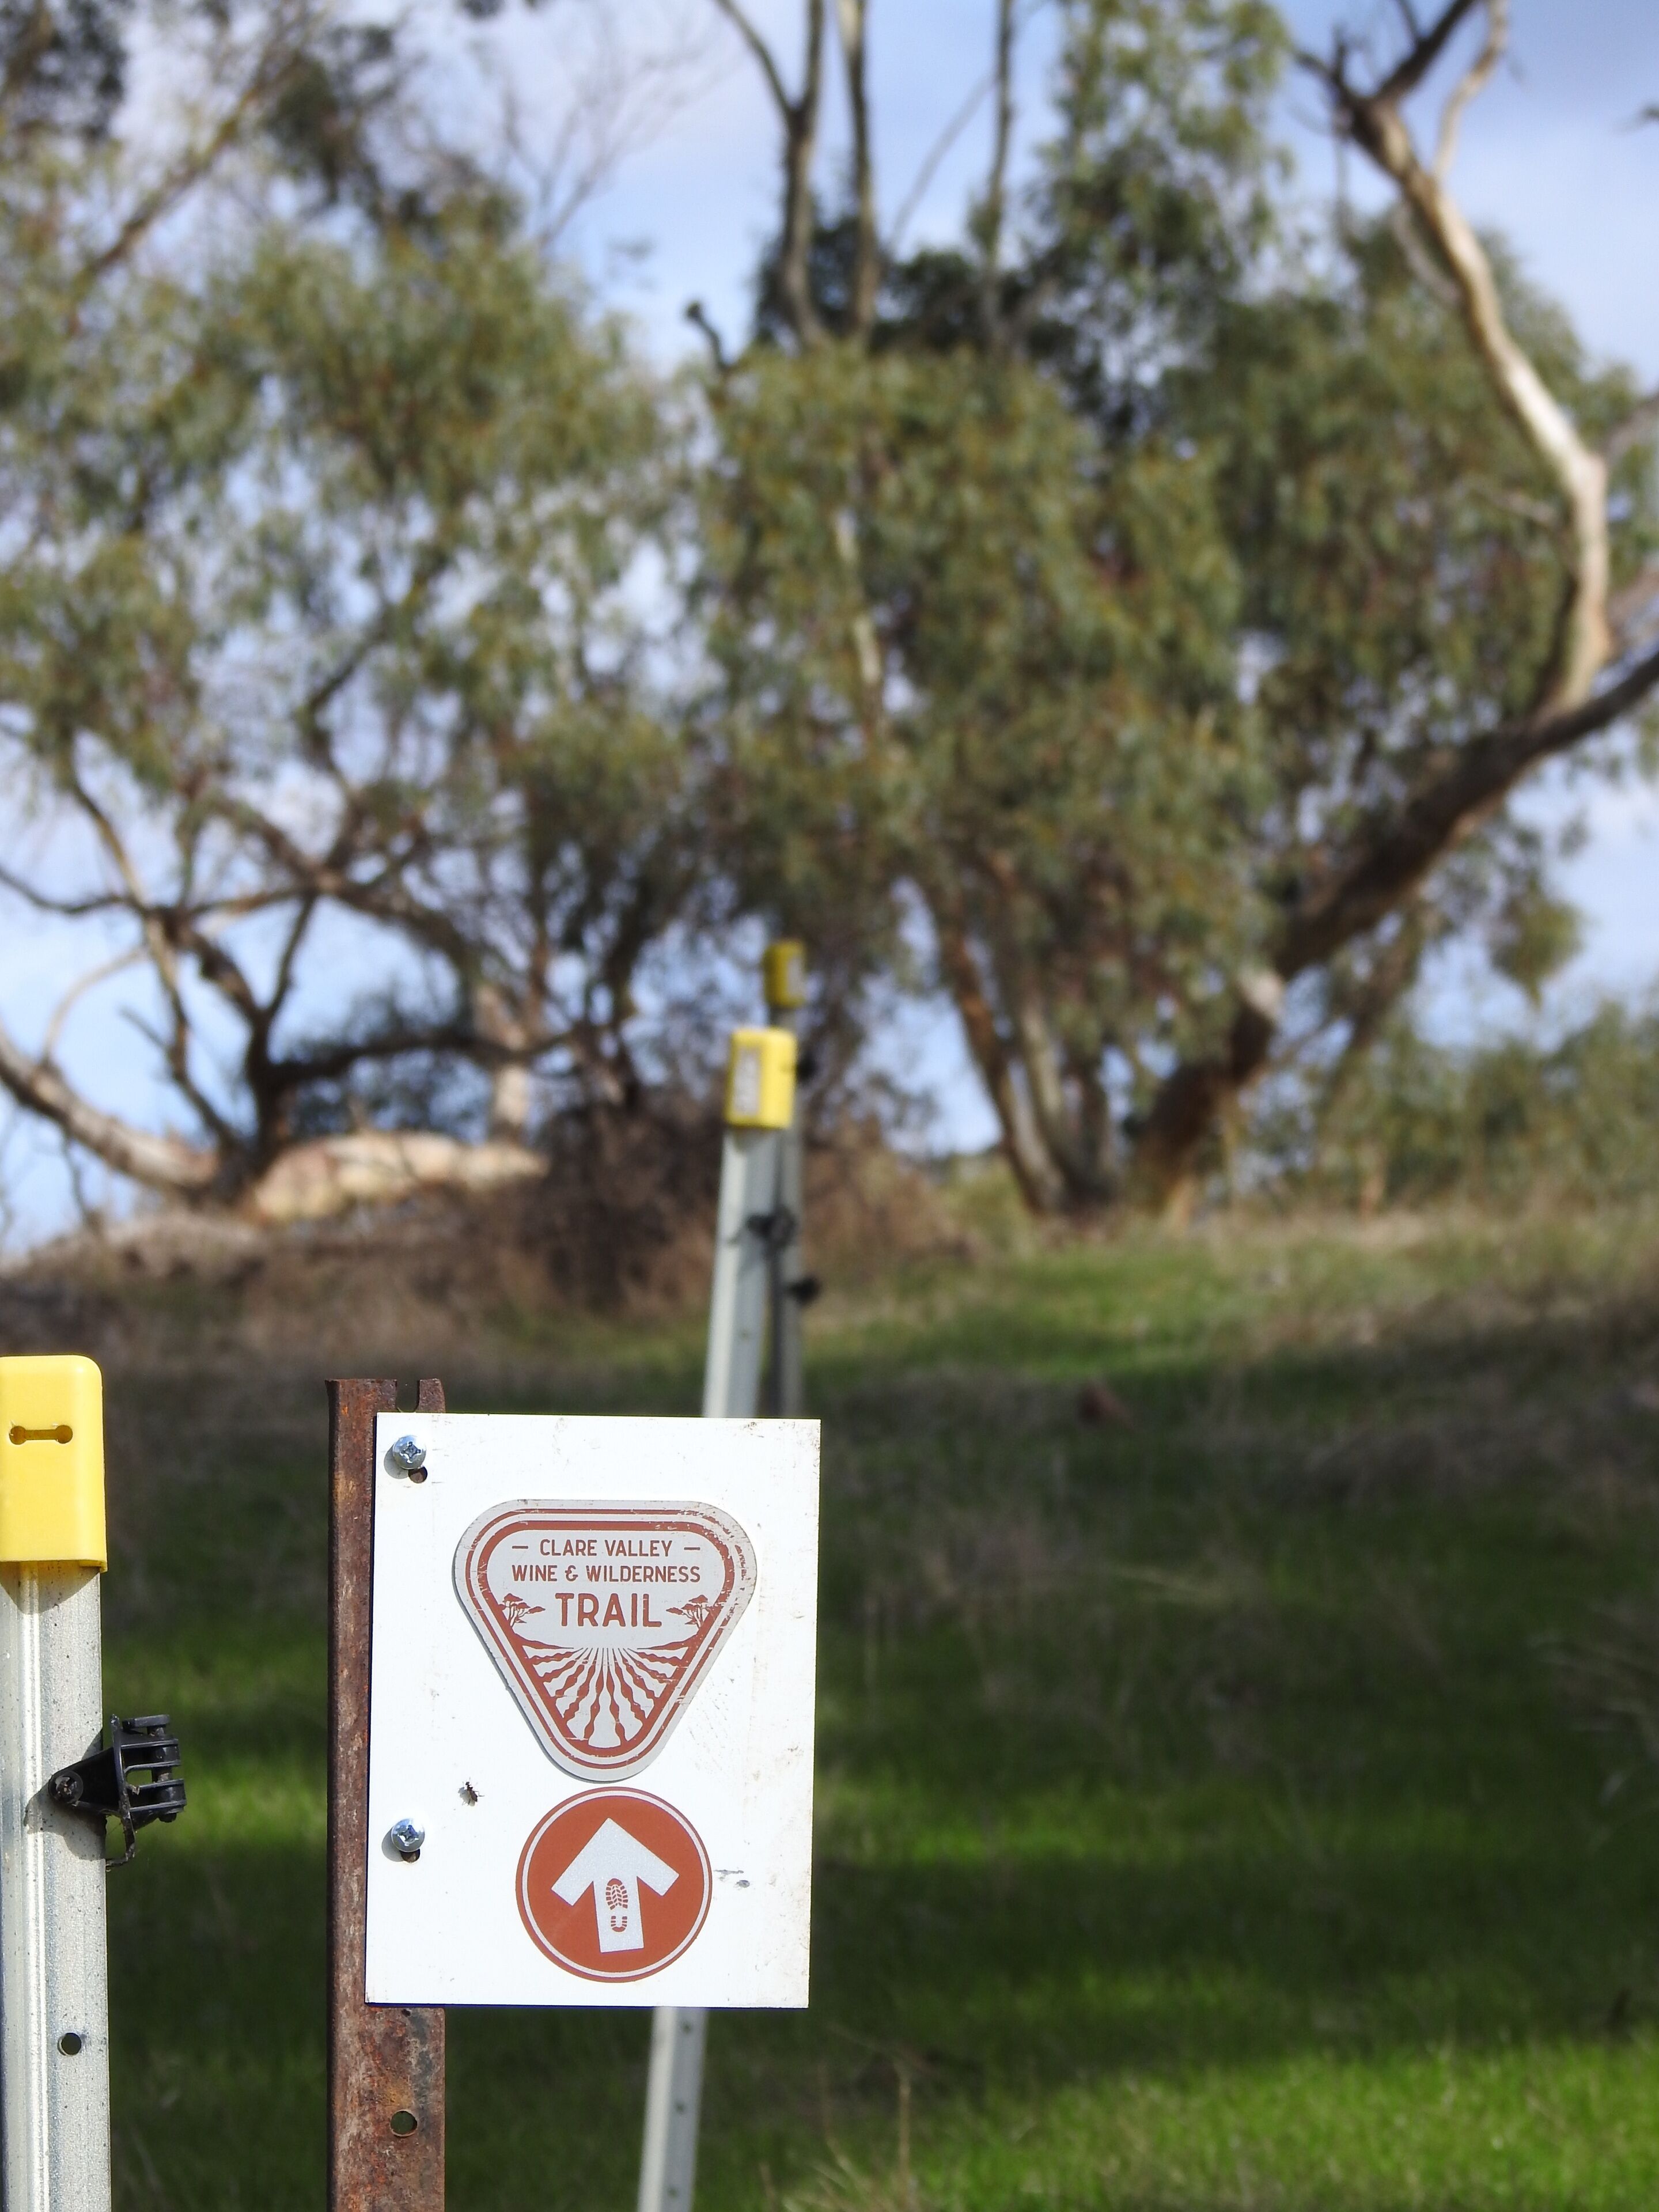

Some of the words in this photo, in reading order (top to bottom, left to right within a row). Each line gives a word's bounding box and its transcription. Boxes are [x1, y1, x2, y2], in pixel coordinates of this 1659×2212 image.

[540, 1539, 597, 1556] CLARE
[604, 1539, 673, 1557] VALLEY
[512, 1565, 558, 1582] WINE
[564, 1565, 578, 1582] &
[586, 1565, 701, 1583] WILDERNESS
[555, 1592, 662, 1627] TRAIL
